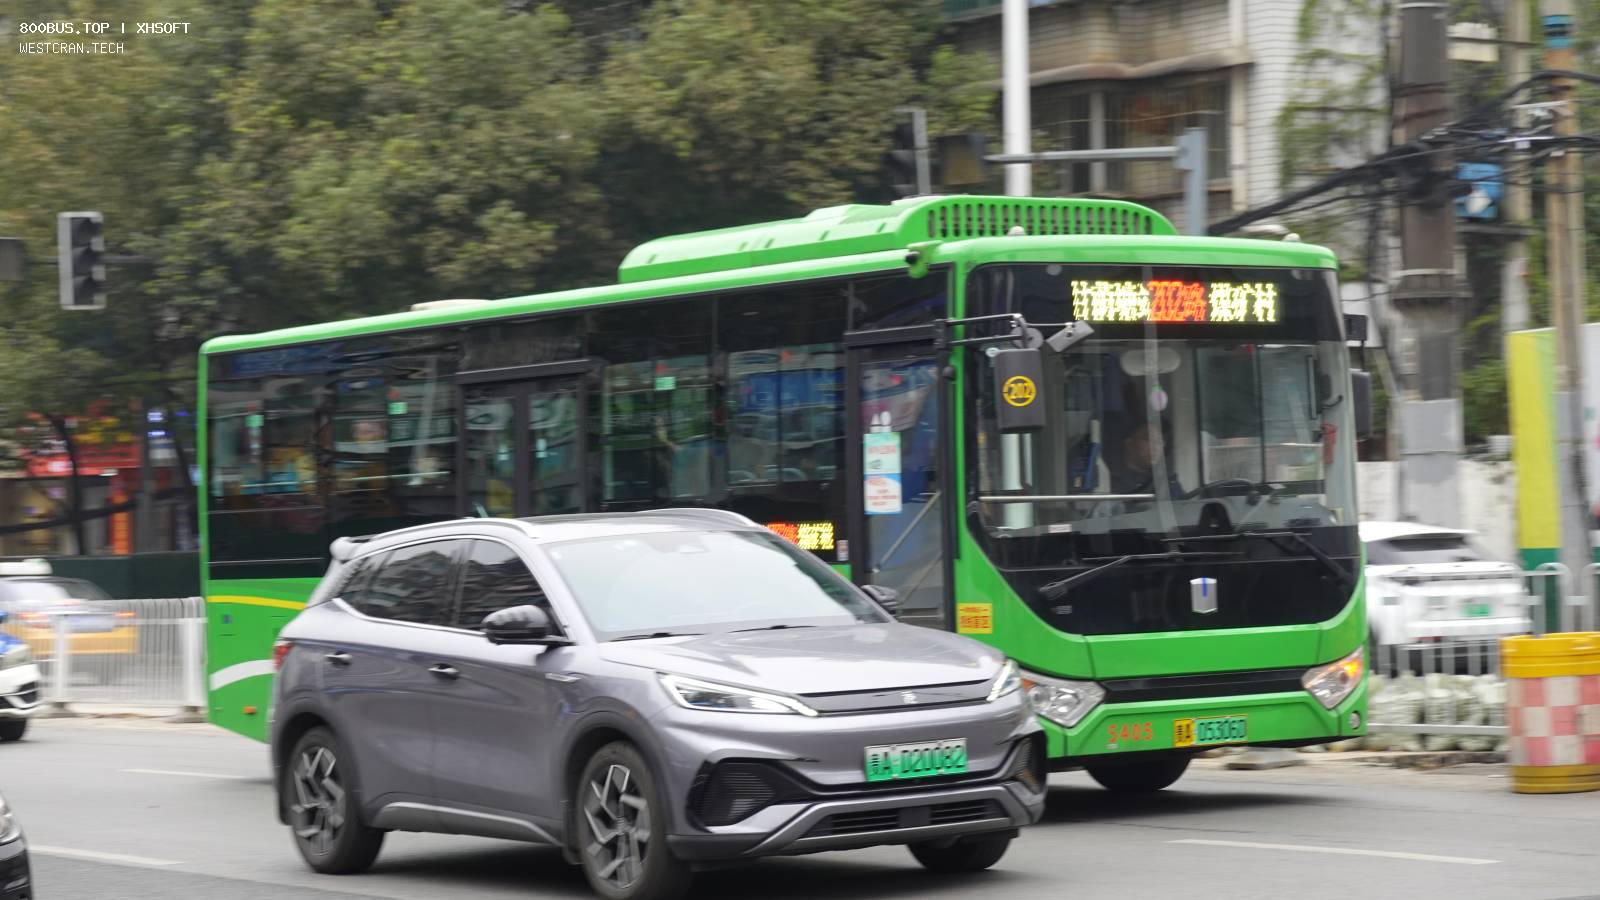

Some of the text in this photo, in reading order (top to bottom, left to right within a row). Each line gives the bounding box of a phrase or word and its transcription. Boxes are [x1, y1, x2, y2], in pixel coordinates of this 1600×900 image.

[1008, 382, 1033, 398] 202
[1108, 721, 1154, 743] 5405
[900, 745, 967, 774] D20082
